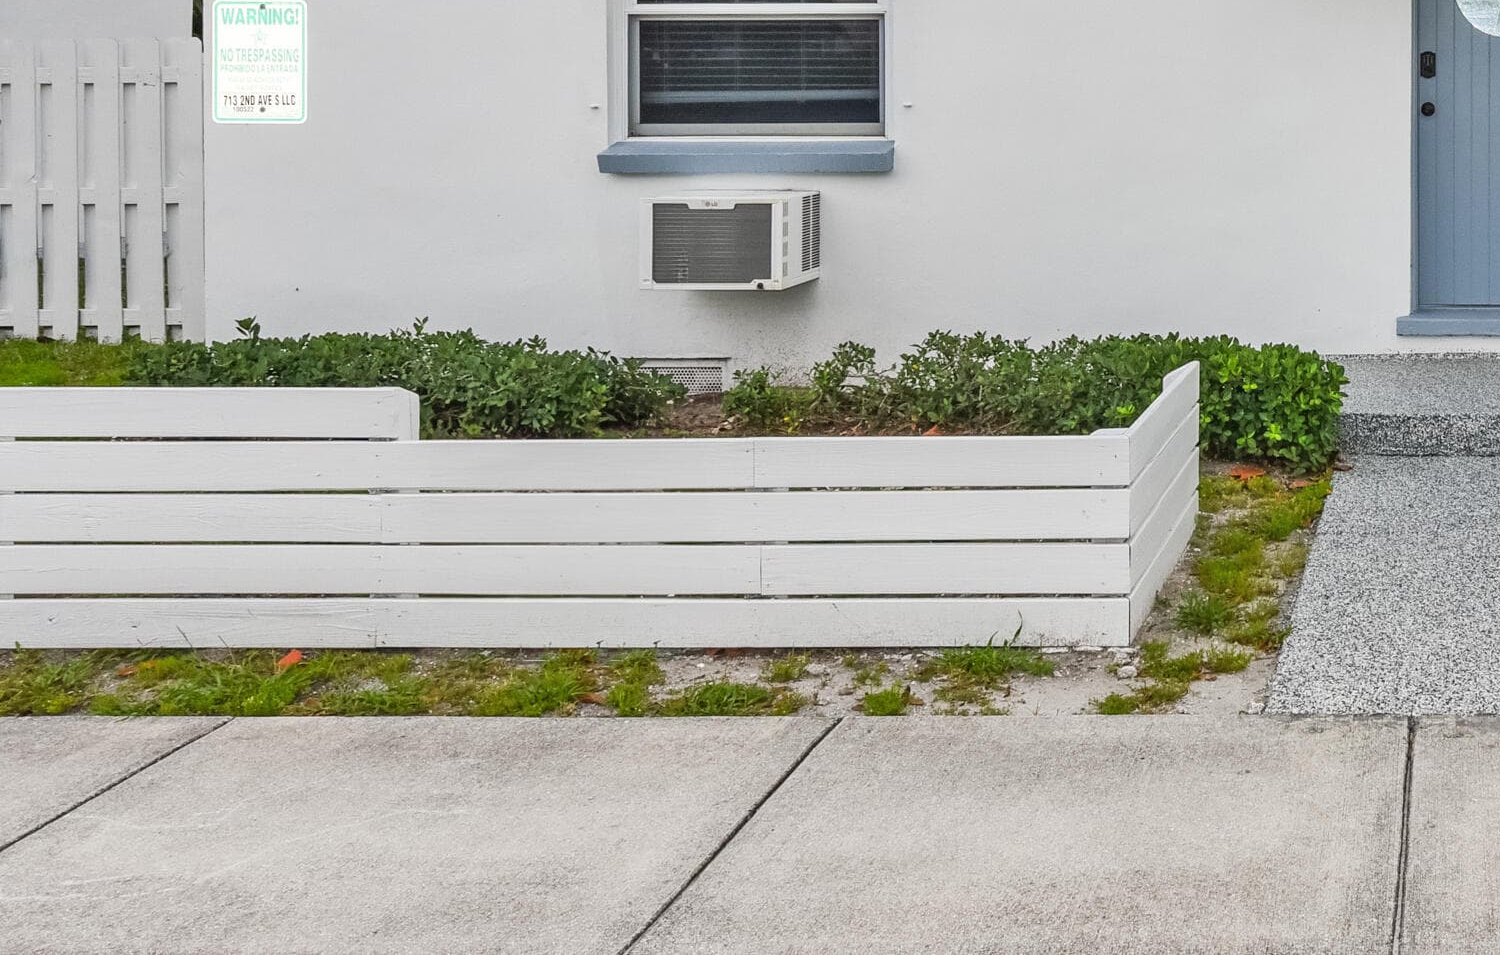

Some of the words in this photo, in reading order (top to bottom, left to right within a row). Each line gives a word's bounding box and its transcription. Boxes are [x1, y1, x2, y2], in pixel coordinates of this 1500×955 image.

[220, 7, 299, 25] WARNING!
[220, 48, 234, 62] NO
[235, 48, 300, 63] TRESPASSING
[223, 95, 238, 107] 713
[240, 95, 256, 106] 2ND
[258, 94, 272, 106] AVE
[275, 94, 280, 106] S
[281, 94, 296, 106] LLC
